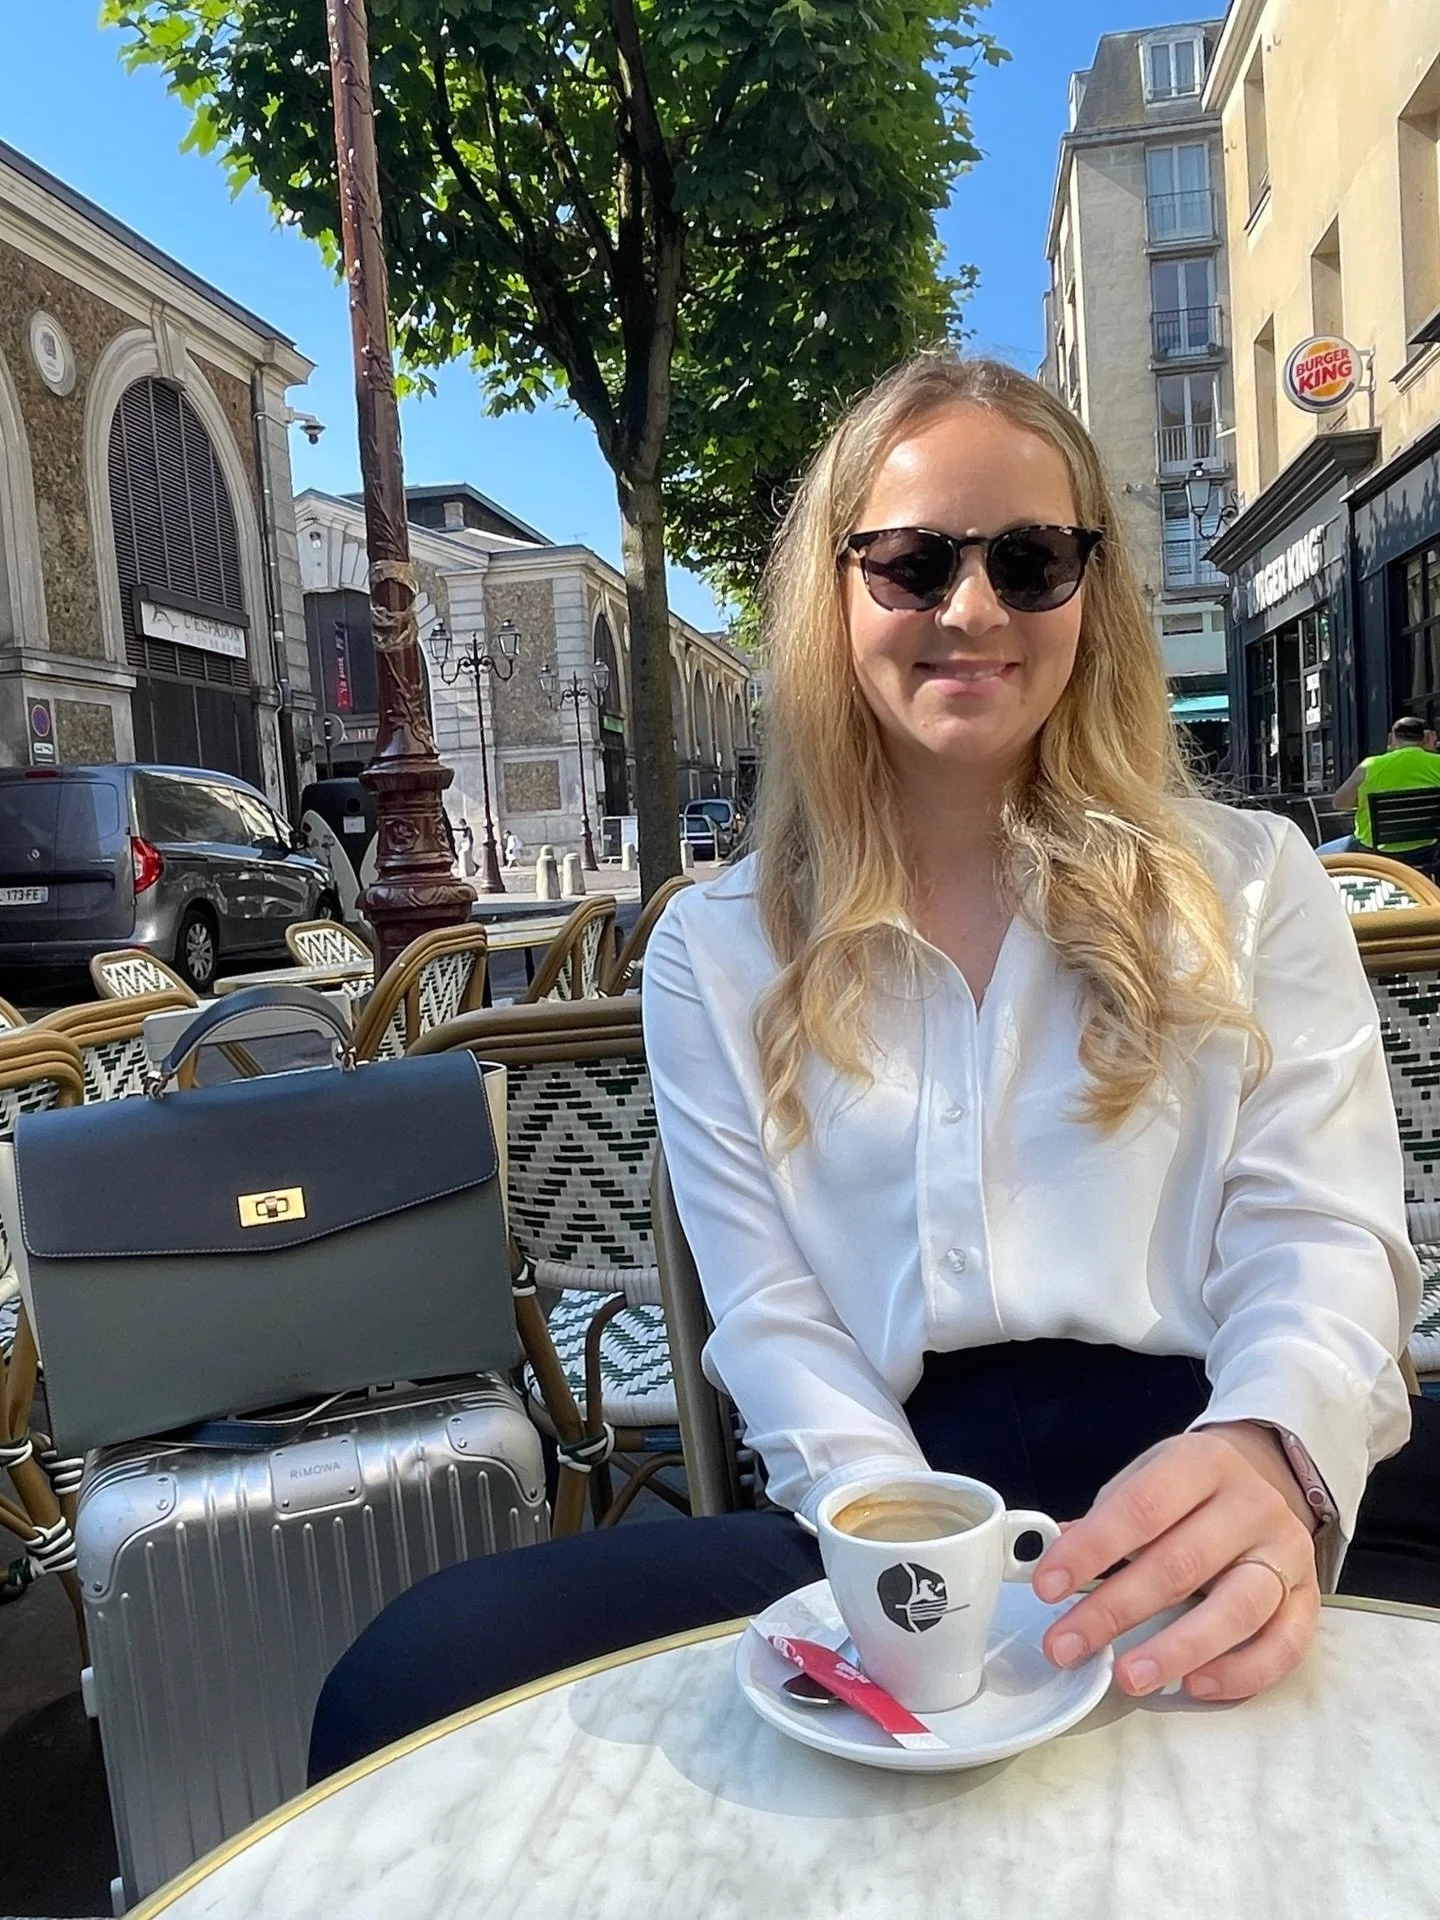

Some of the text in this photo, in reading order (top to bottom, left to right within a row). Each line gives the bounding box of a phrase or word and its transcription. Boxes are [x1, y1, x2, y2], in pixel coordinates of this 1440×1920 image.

[1296, 348, 1349, 377] BURGER
[1299, 360, 1352, 396] KING
[1286, 524, 1324, 592] KING
[289, 1461, 341, 1480] RIMOWA
